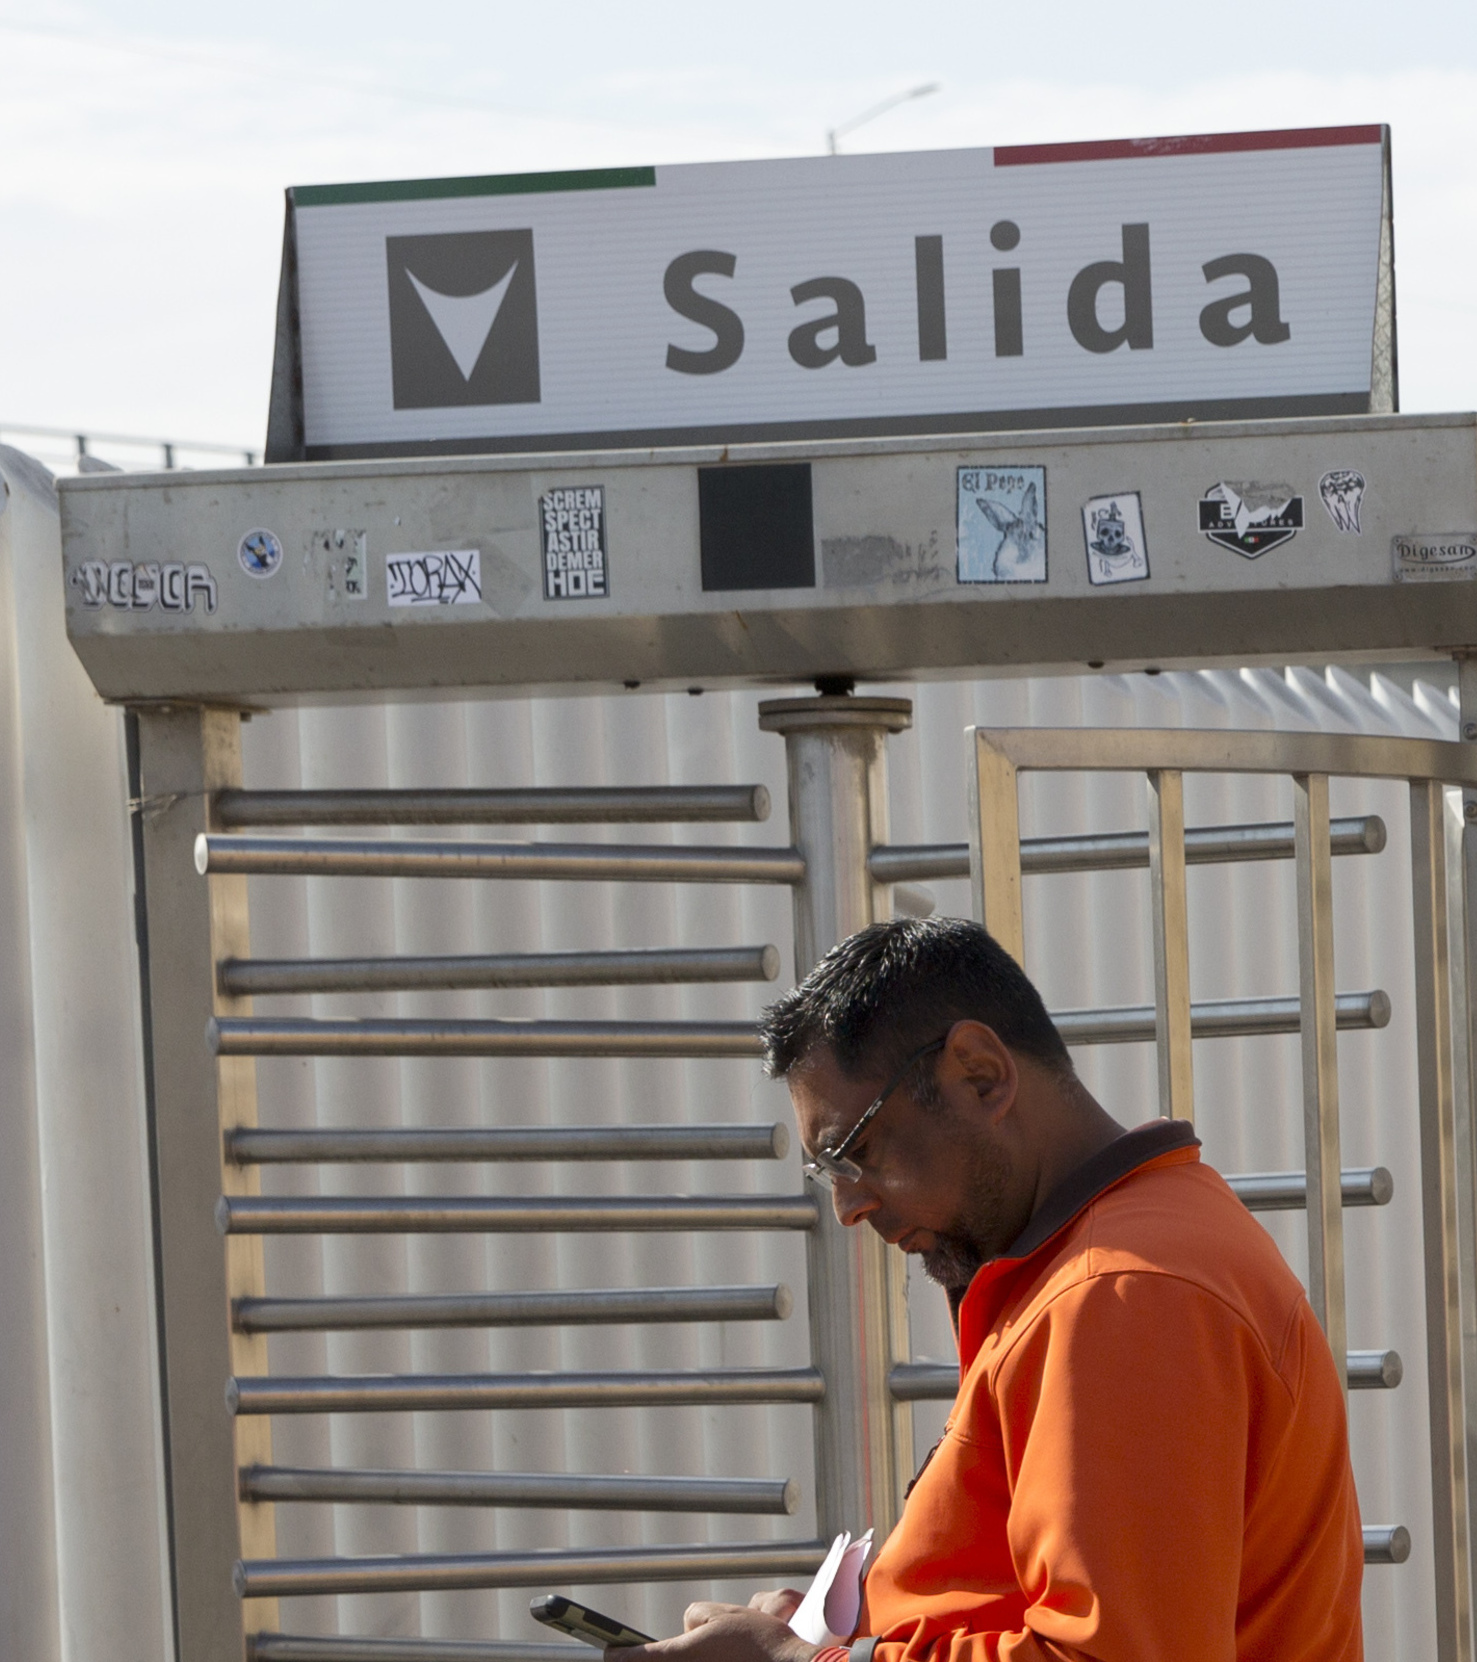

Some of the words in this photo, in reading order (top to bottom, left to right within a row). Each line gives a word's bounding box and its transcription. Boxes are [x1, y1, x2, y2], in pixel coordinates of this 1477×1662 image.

[662, 219, 1291, 376] Salida
[543, 489, 601, 511] SCREM
[545, 508, 601, 532] SPECT
[548, 530, 599, 552] ASTIR
[1398, 543, 1471, 561] Digesan
[547, 551, 603, 571] DEMER
